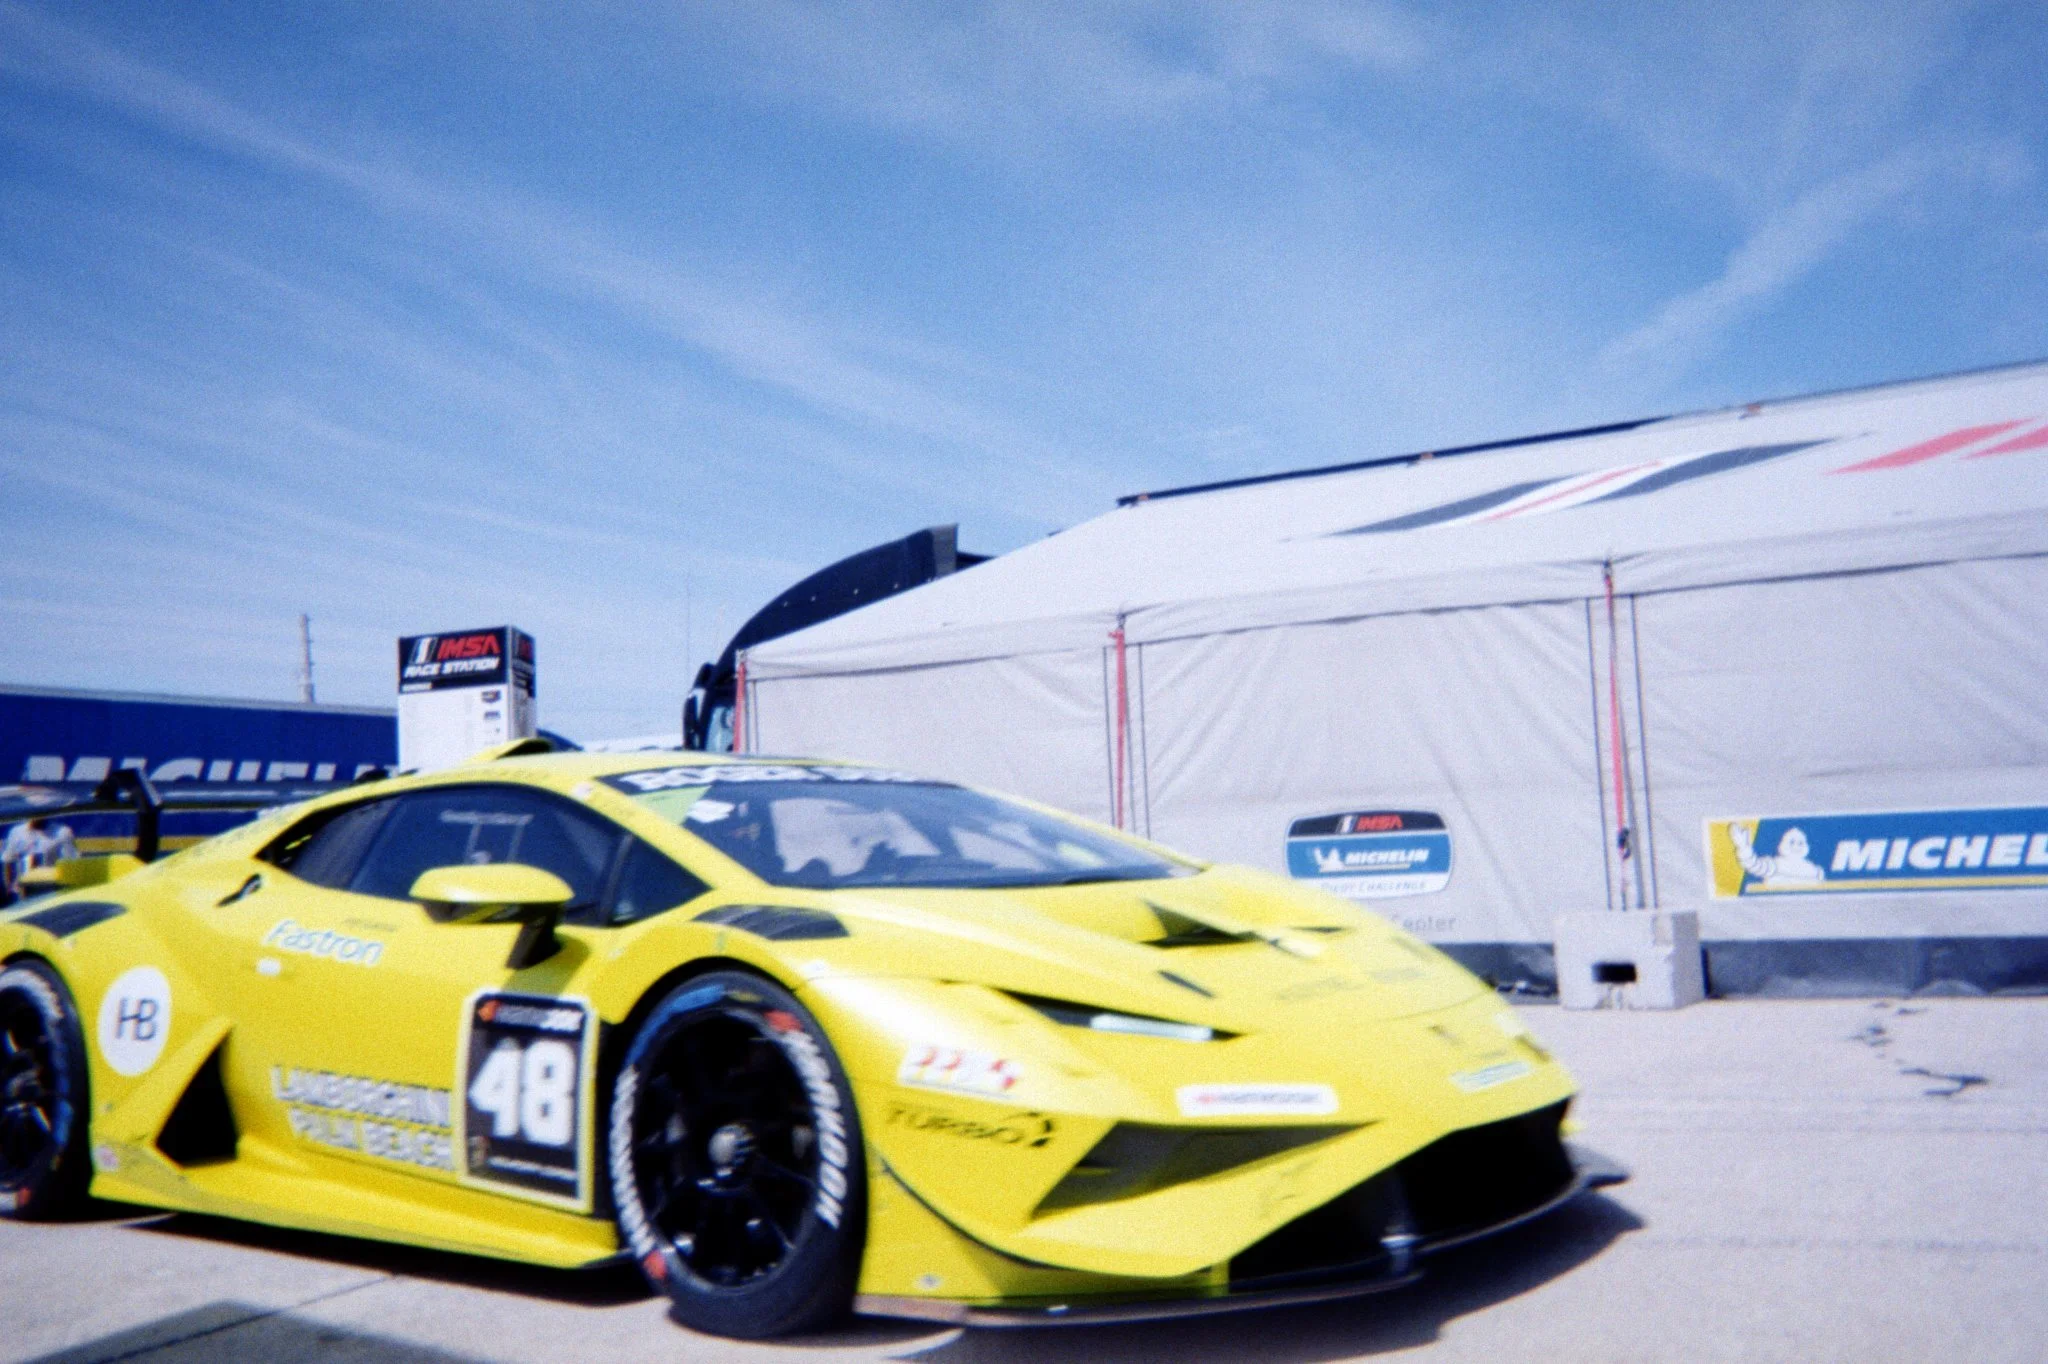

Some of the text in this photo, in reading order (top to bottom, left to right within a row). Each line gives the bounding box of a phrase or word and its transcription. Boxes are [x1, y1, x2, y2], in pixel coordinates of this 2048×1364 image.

[437, 634, 501, 661] IMSA
[403, 657, 501, 678] RACE STATION
[1355, 814, 1404, 831] IMSA
[1344, 849, 1429, 865] MICHELIN
[1830, 833, 2048, 872] MICHEL
[261, 918, 384, 967] Fastron
[468, 1037, 576, 1147] 48
